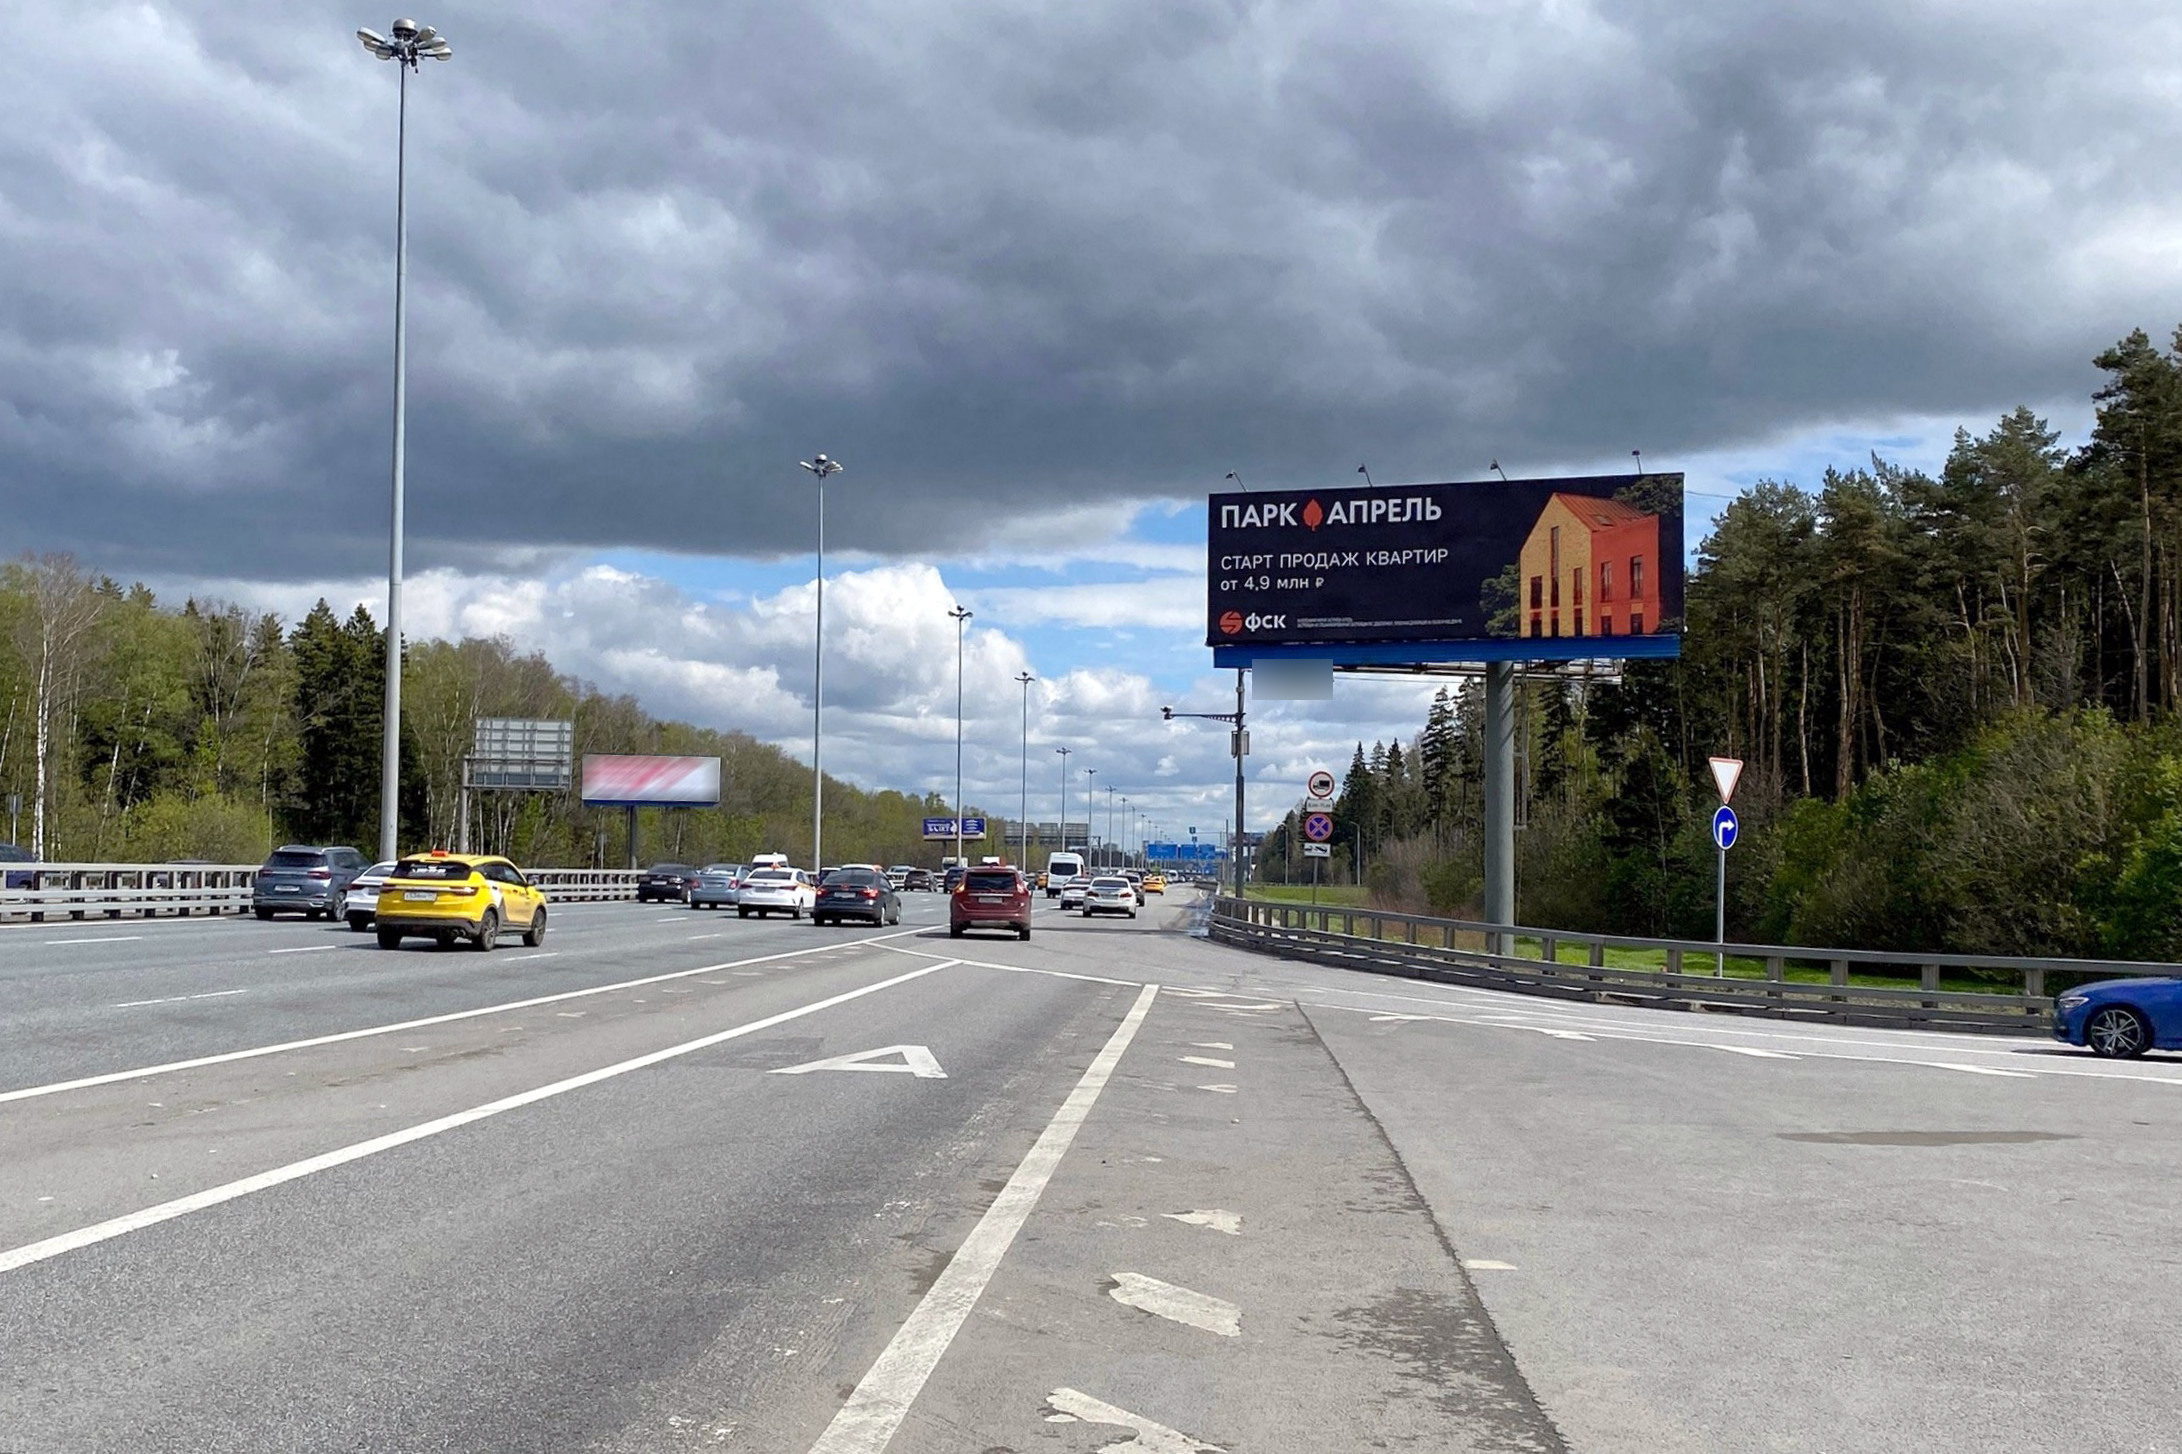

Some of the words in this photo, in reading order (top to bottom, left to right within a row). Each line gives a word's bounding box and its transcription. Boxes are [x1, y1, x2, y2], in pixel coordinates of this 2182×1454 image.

[1221, 502, 1298, 529] ПАРК
[1326, 497, 1442, 524] АПРЕЛЬ
[1221, 554, 1274, 570] СТАРТ
[1280, 552, 1359, 570] ПРОДАЖ
[1366, 548, 1449, 566] КВАРТИР
[1220, 578, 1238, 591] от
[1244, 576, 1270, 592] 4,9
[1277, 578, 1309, 589] млн
